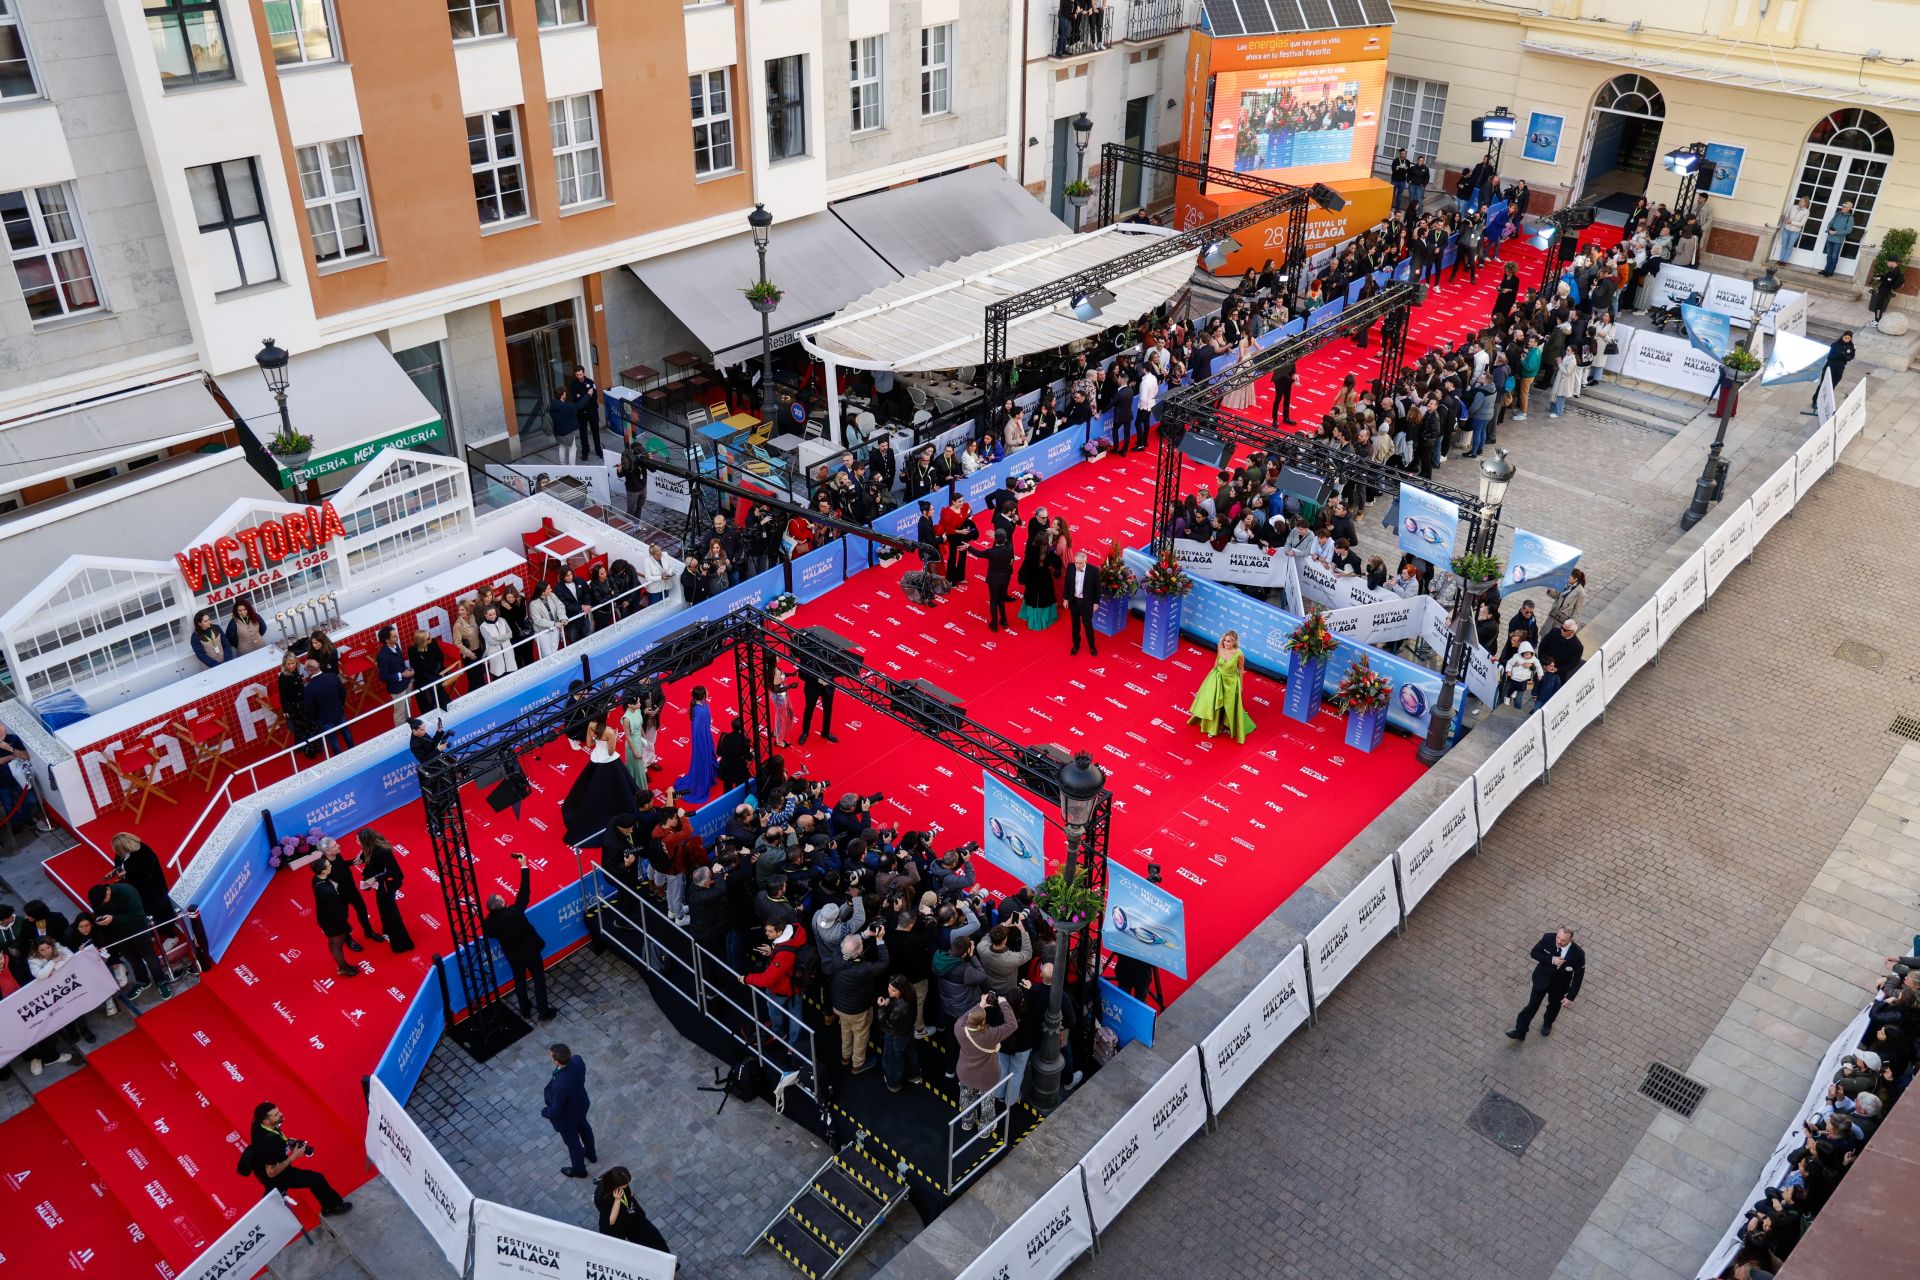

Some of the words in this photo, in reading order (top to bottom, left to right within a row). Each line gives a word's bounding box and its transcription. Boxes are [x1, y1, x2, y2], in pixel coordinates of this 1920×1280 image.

[1249, 38, 1289, 51] energías
[1245, 53, 1262, 61] ahora
[1279, 50, 1304, 58] festival
[1306, 48, 1330, 56] favorito
[1185, 204, 1197, 224] 28
[1264, 227, 1284, 247] 28
[287, 457, 347, 483] TQUERÍA
[175, 500, 347, 592] VICTORIA
[295, 550, 329, 570] 1928
[1304, 565, 1327, 579] FESTIVAL
[1374, 609, 1401, 619] FESTIVAL
[1086, 711, 1103, 722] rtve
[1069, 726, 1084, 736] iryo
[306, 797, 342, 818] FESTIVAL
[344, 791, 355, 800] DE
[950, 802, 967, 815] rtve
[1264, 800, 1284, 813] rtve
[1249, 818, 1266, 830] iryo
[358, 960, 375, 975] rtve
[17, 979, 62, 1016] FESTIVAL
[64, 972, 78, 984] DE
[1244, 1023, 1250, 1033] DE
[194, 1030, 211, 1044] SUR
[309, 1035, 325, 1050] iryo
[222, 1060, 245, 1083] málaga
[1152, 1095, 1179, 1120] FESTIVAL
[1180, 1082, 1188, 1094] DE
[154, 1117, 170, 1134] iryo
[1130, 1134, 1138, 1146] DE
[127, 1222, 145, 1243] rtve
[248, 1224, 261, 1238] DE
[1026, 1217, 1060, 1250] FESTIVAL
[1061, 1205, 1070, 1216] DE
[497, 1235, 544, 1254] FESTIVAL
[548, 1249, 560, 1258] DE
[158, 1260, 174, 1279] SUR
